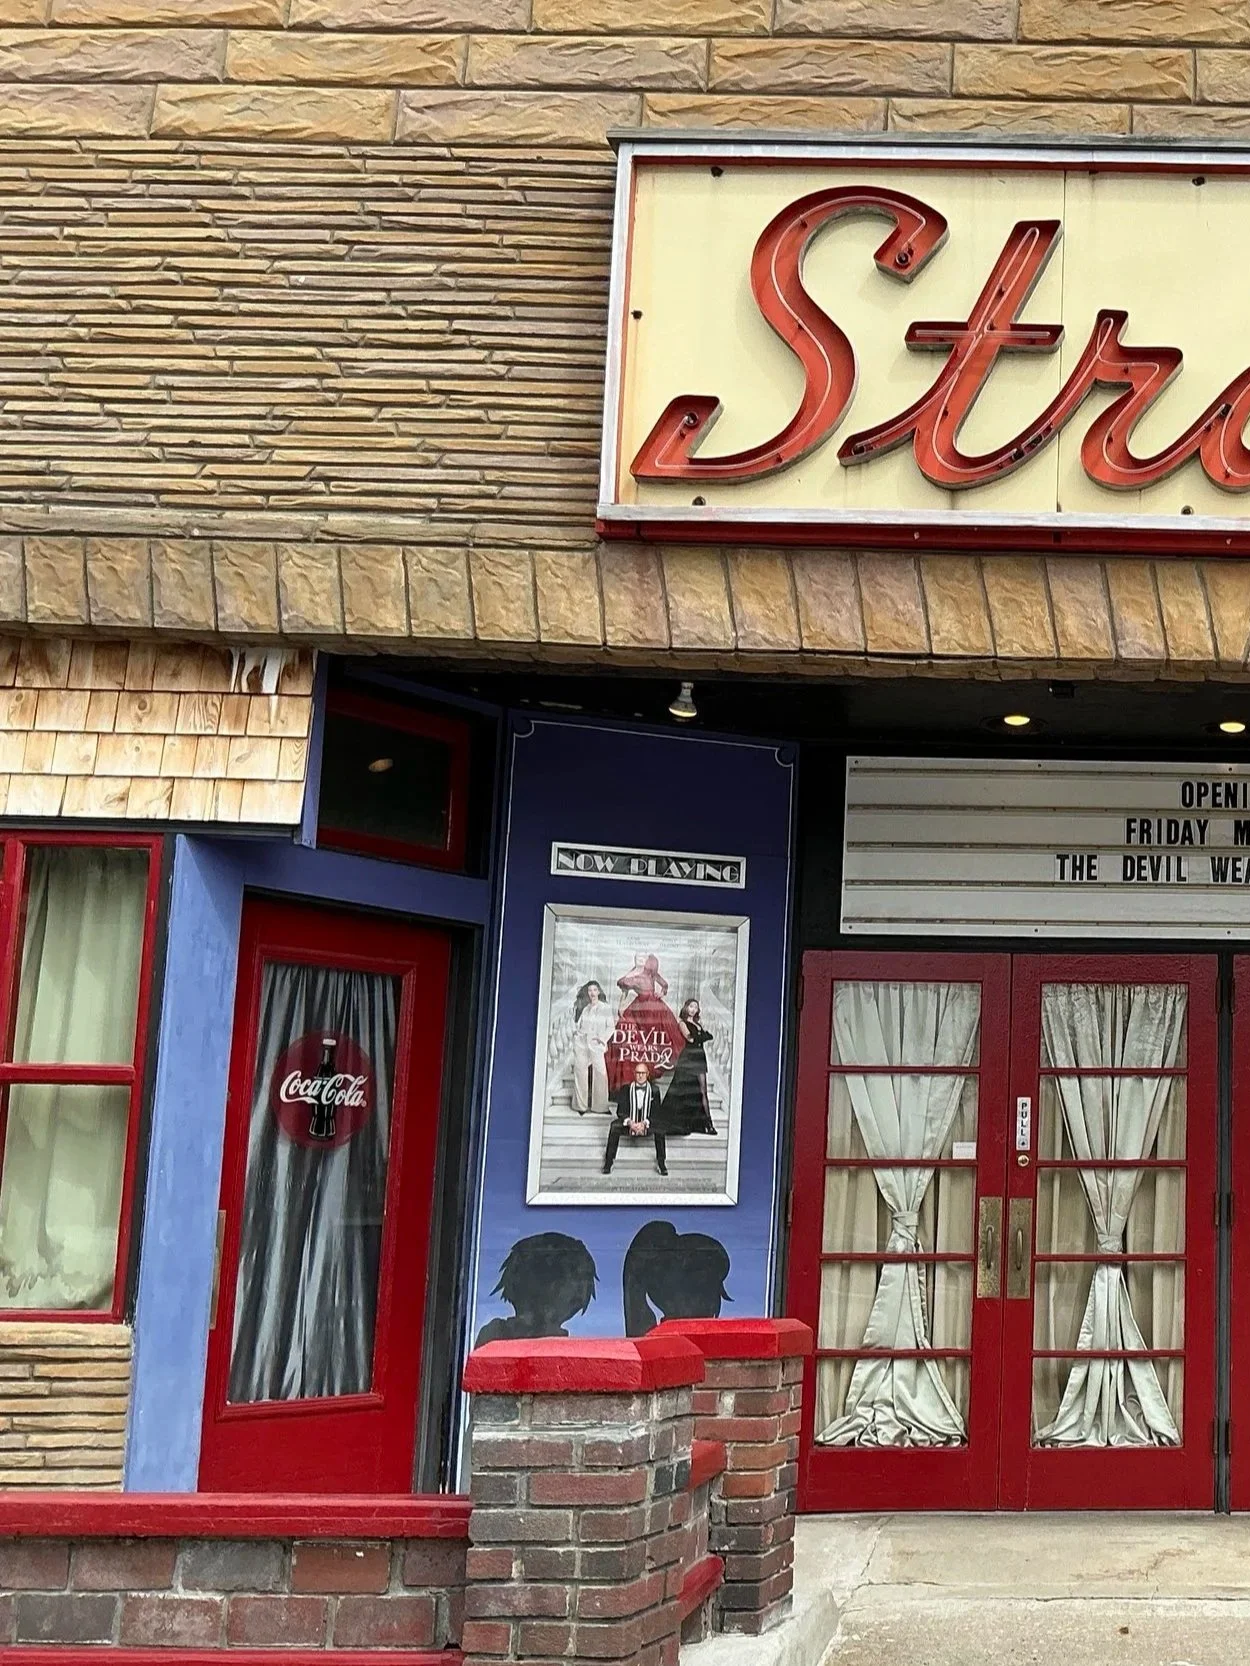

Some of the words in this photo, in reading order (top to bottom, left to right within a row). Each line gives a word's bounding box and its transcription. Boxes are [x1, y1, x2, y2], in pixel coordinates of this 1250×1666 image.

[1125, 818, 1209, 846] FRIDAY
[557, 851, 619, 873] NOW
[629, 857, 740, 882] PLAYING
[1055, 854, 1098, 881] THE
[1122, 854, 1188, 883] DEVIL
[611, 1026, 673, 1046] DEVIL
[620, 1023, 637, 1031] THE
[629, 1043, 658, 1052] WEARS
[1020, 1102, 1028, 1137] PULL
